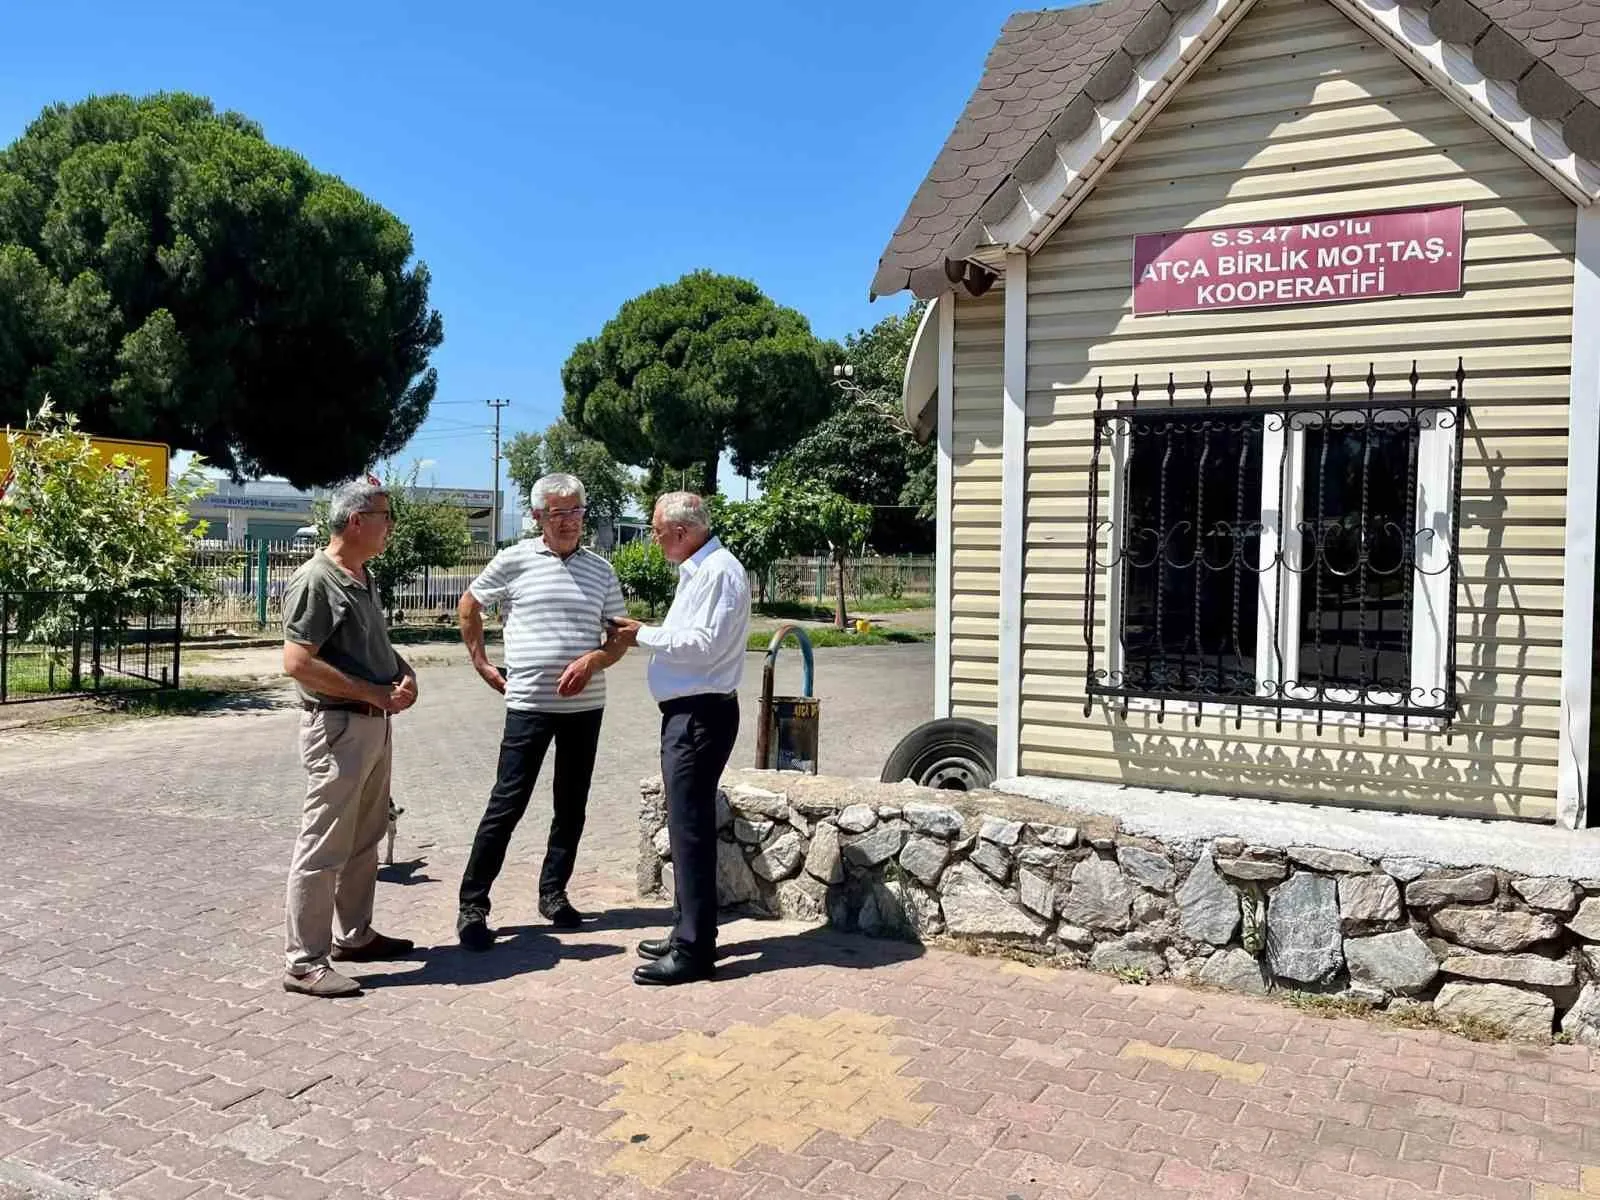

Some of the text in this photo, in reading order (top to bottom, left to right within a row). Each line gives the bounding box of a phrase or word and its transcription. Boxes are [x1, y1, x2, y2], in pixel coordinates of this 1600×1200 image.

[1211, 219, 1371, 247] S.S.47 No'lu
[1139, 259, 1210, 284] ATÇA
[1218, 246, 1309, 276] BİRLİK
[1197, 266, 1385, 305] KOOPERATİFİ
